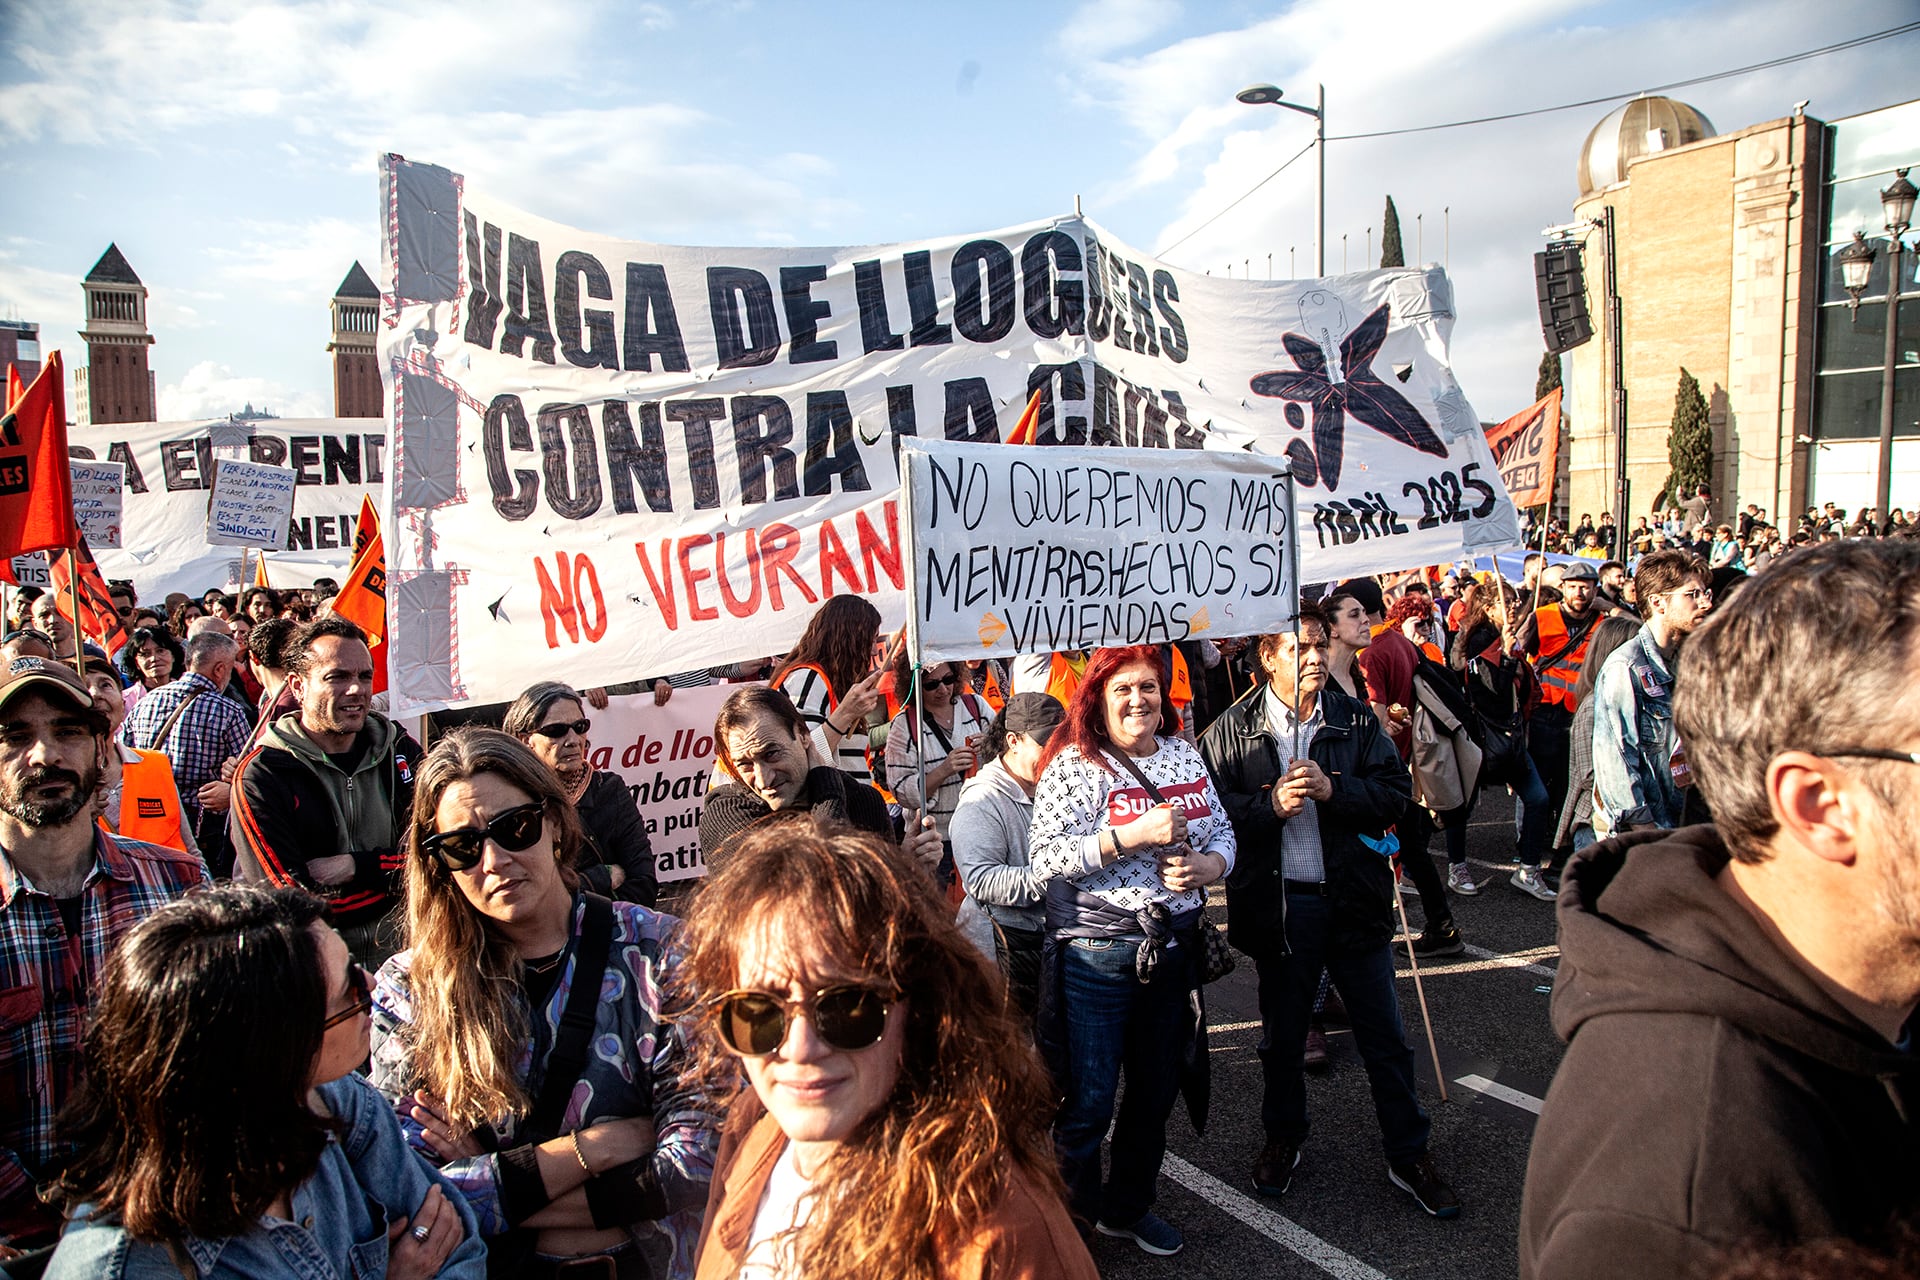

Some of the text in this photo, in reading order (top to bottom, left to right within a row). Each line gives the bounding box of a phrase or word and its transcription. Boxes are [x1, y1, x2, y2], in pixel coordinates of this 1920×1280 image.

[463, 206, 1188, 373] VAGA DE LLOGUERS
[222, 463, 240, 474] PER
[240, 467, 256, 477] LES
[482, 389, 872, 521] CONTRA
[929, 454, 1287, 536] NO QUEREMOS MAS
[1402, 462, 1497, 531] 2025
[534, 500, 906, 649] NO VEURAN
[1003, 599, 1190, 654] VIVIENDAS
[621, 734, 663, 769] de
[627, 769, 712, 805] mbat
